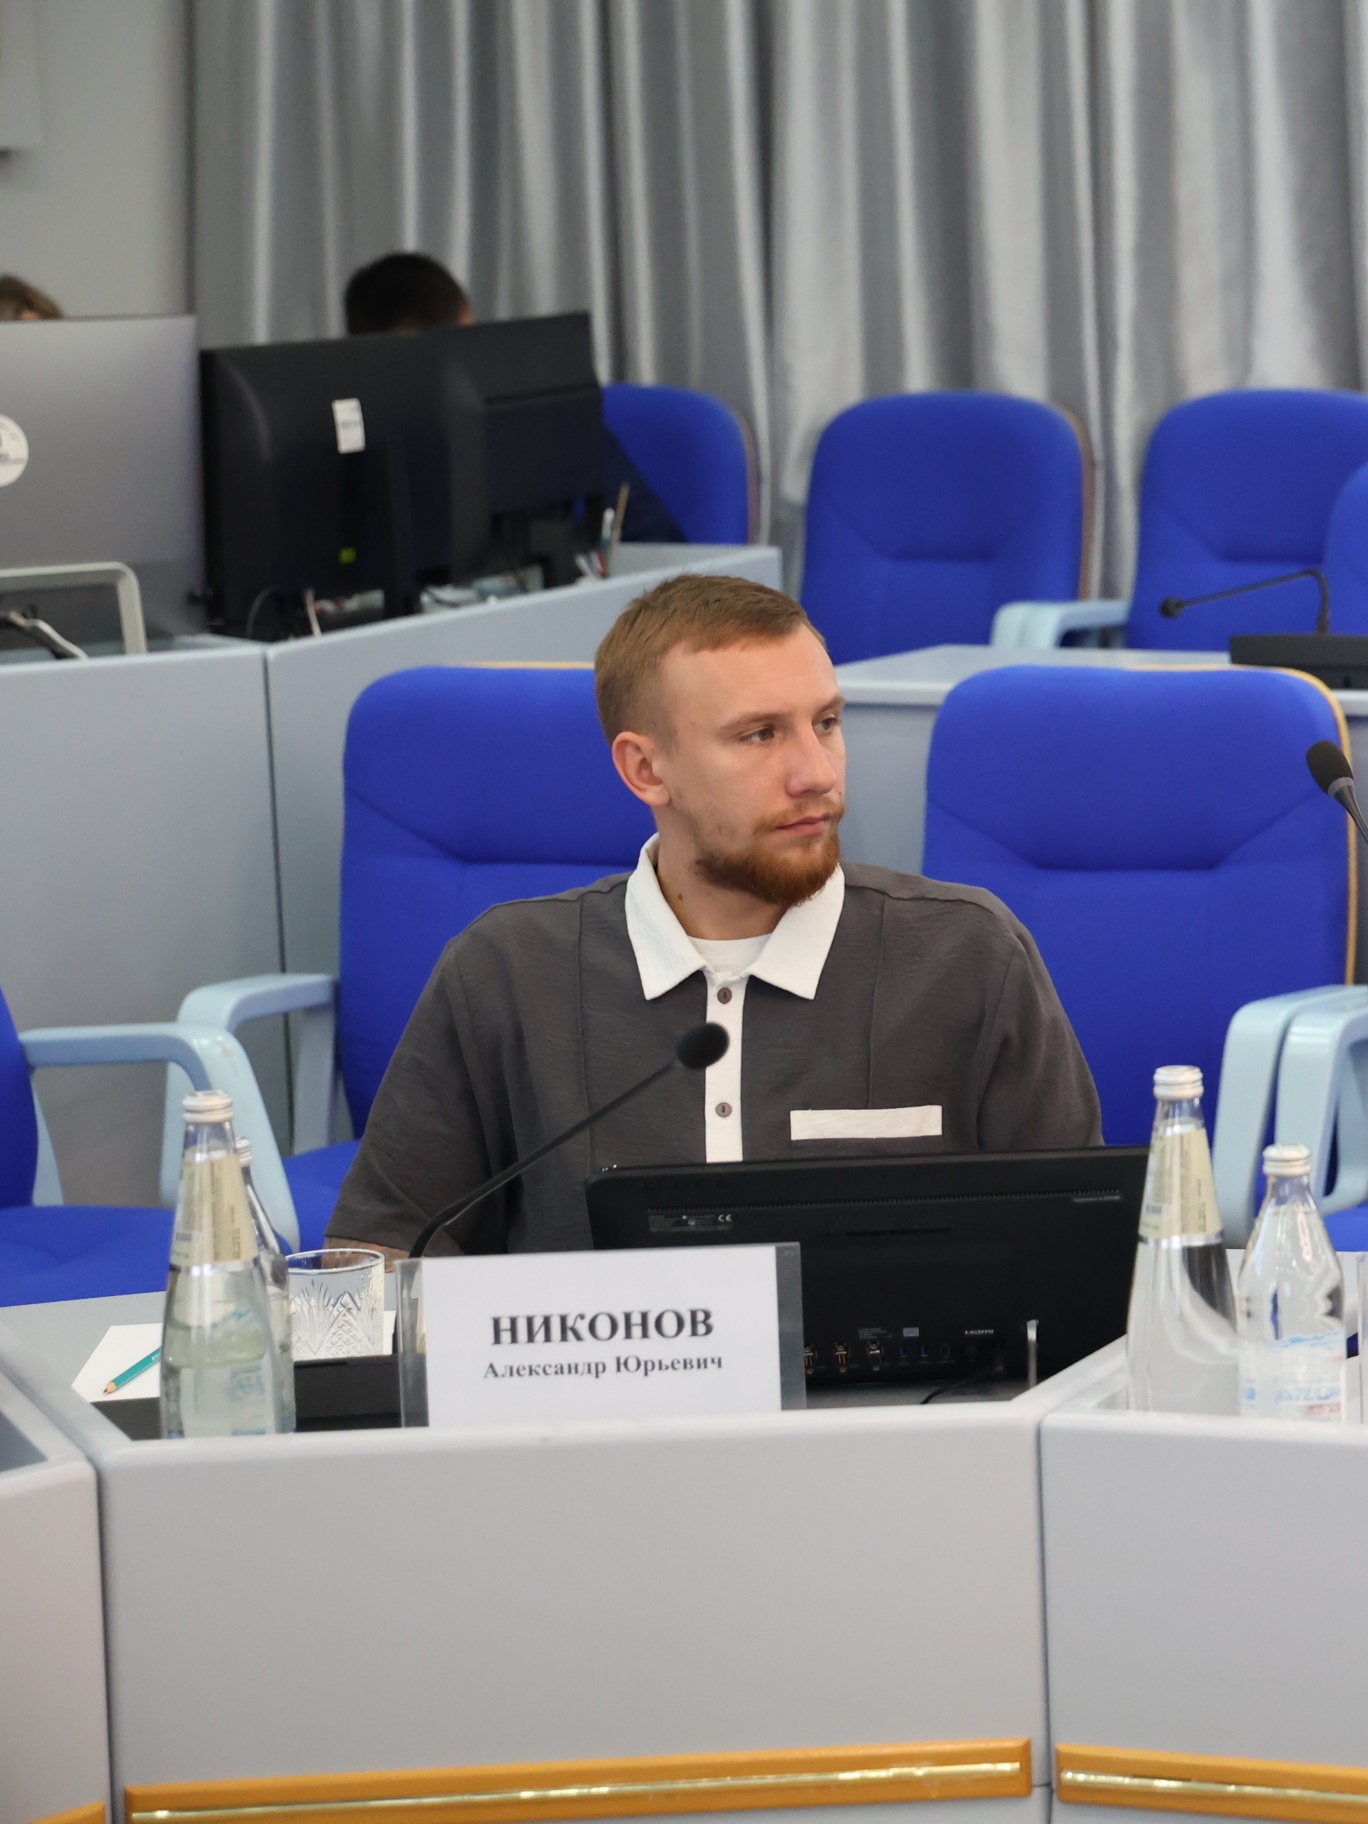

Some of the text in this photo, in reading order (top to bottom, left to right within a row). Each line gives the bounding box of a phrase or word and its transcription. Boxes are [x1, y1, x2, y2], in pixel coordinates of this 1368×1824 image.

[490, 1307, 715, 1346] НИКОНОВ
[483, 1354, 723, 1379] Александр Юрьевич
